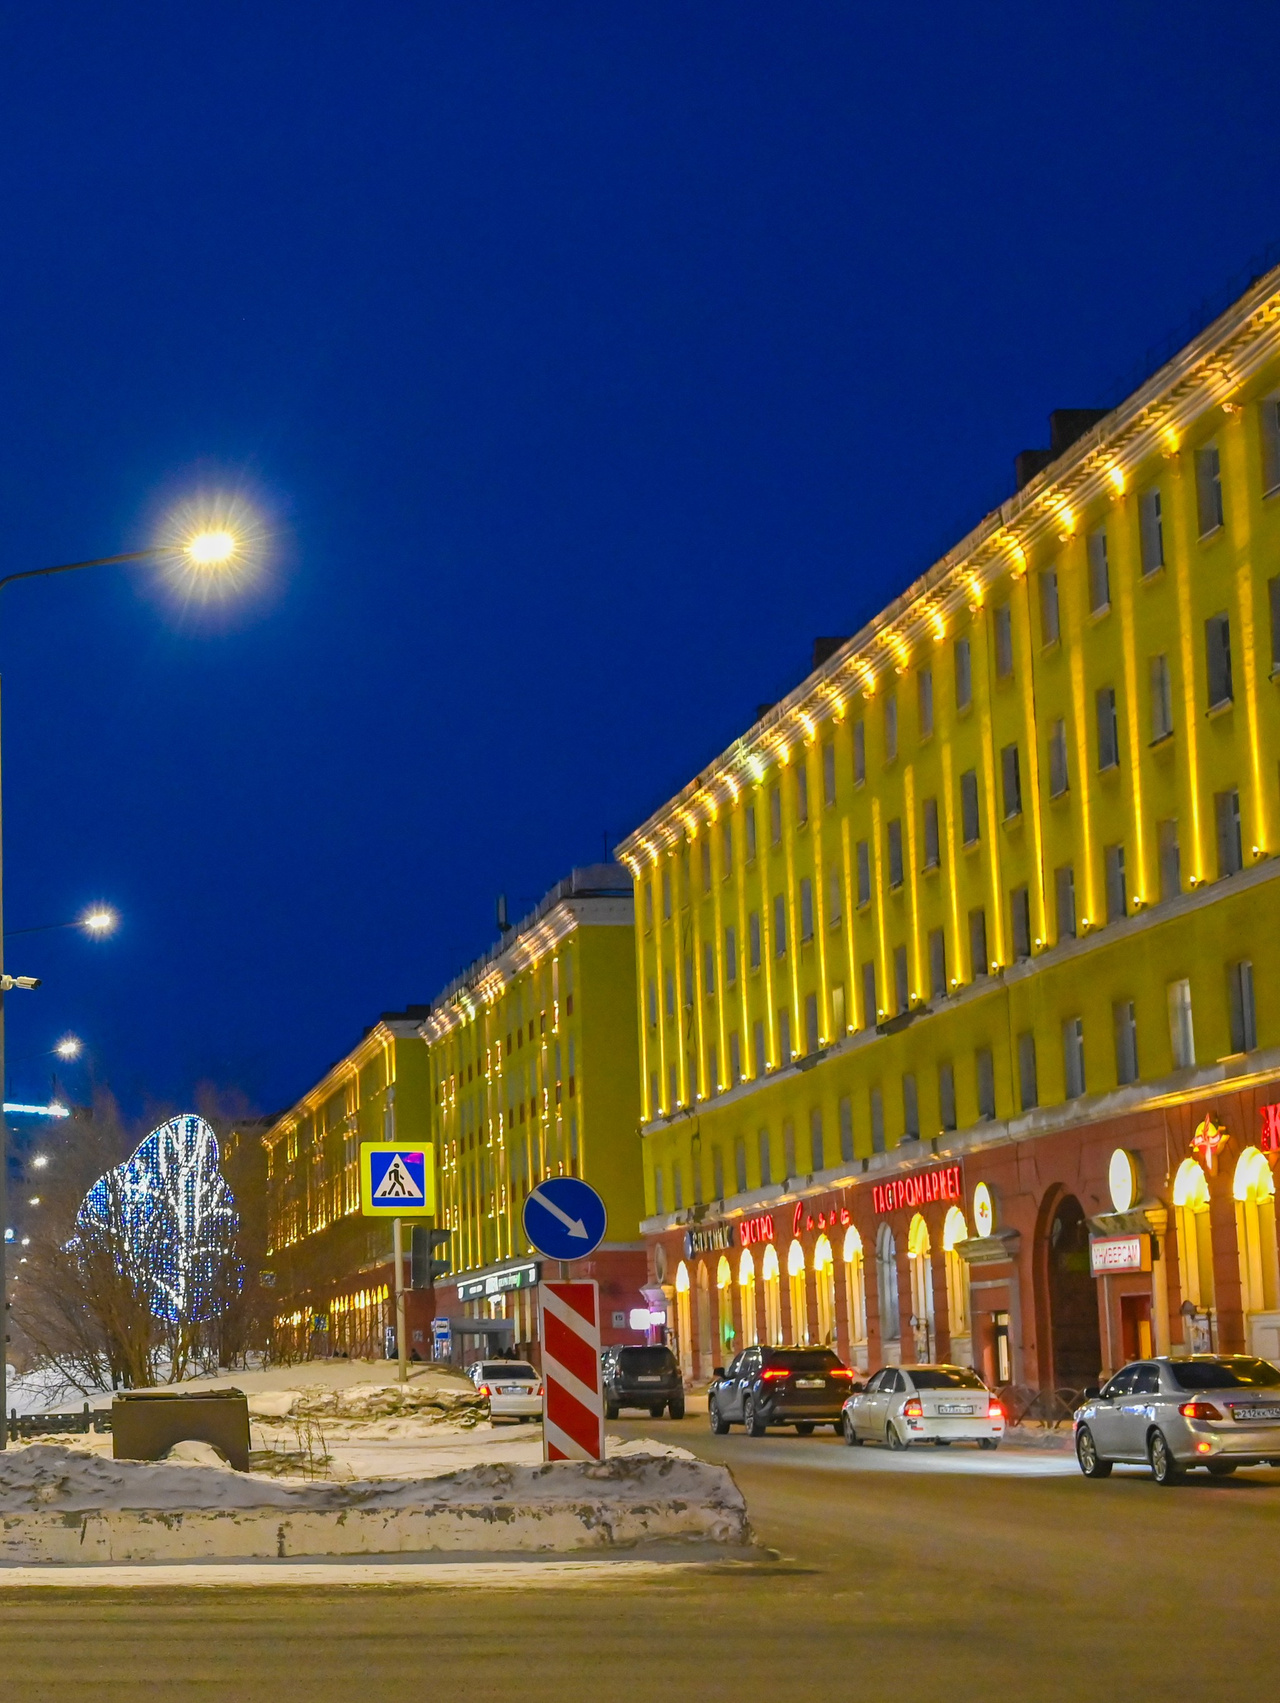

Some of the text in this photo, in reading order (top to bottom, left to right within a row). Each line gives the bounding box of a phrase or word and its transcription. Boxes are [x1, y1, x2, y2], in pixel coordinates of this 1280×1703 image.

[873, 1166, 960, 1213] ГАСТРОМАРКЕТ
[740, 1214, 774, 1246] БИСТРО
[1093, 1244, 1138, 1265] УНИВЕРСАМ
